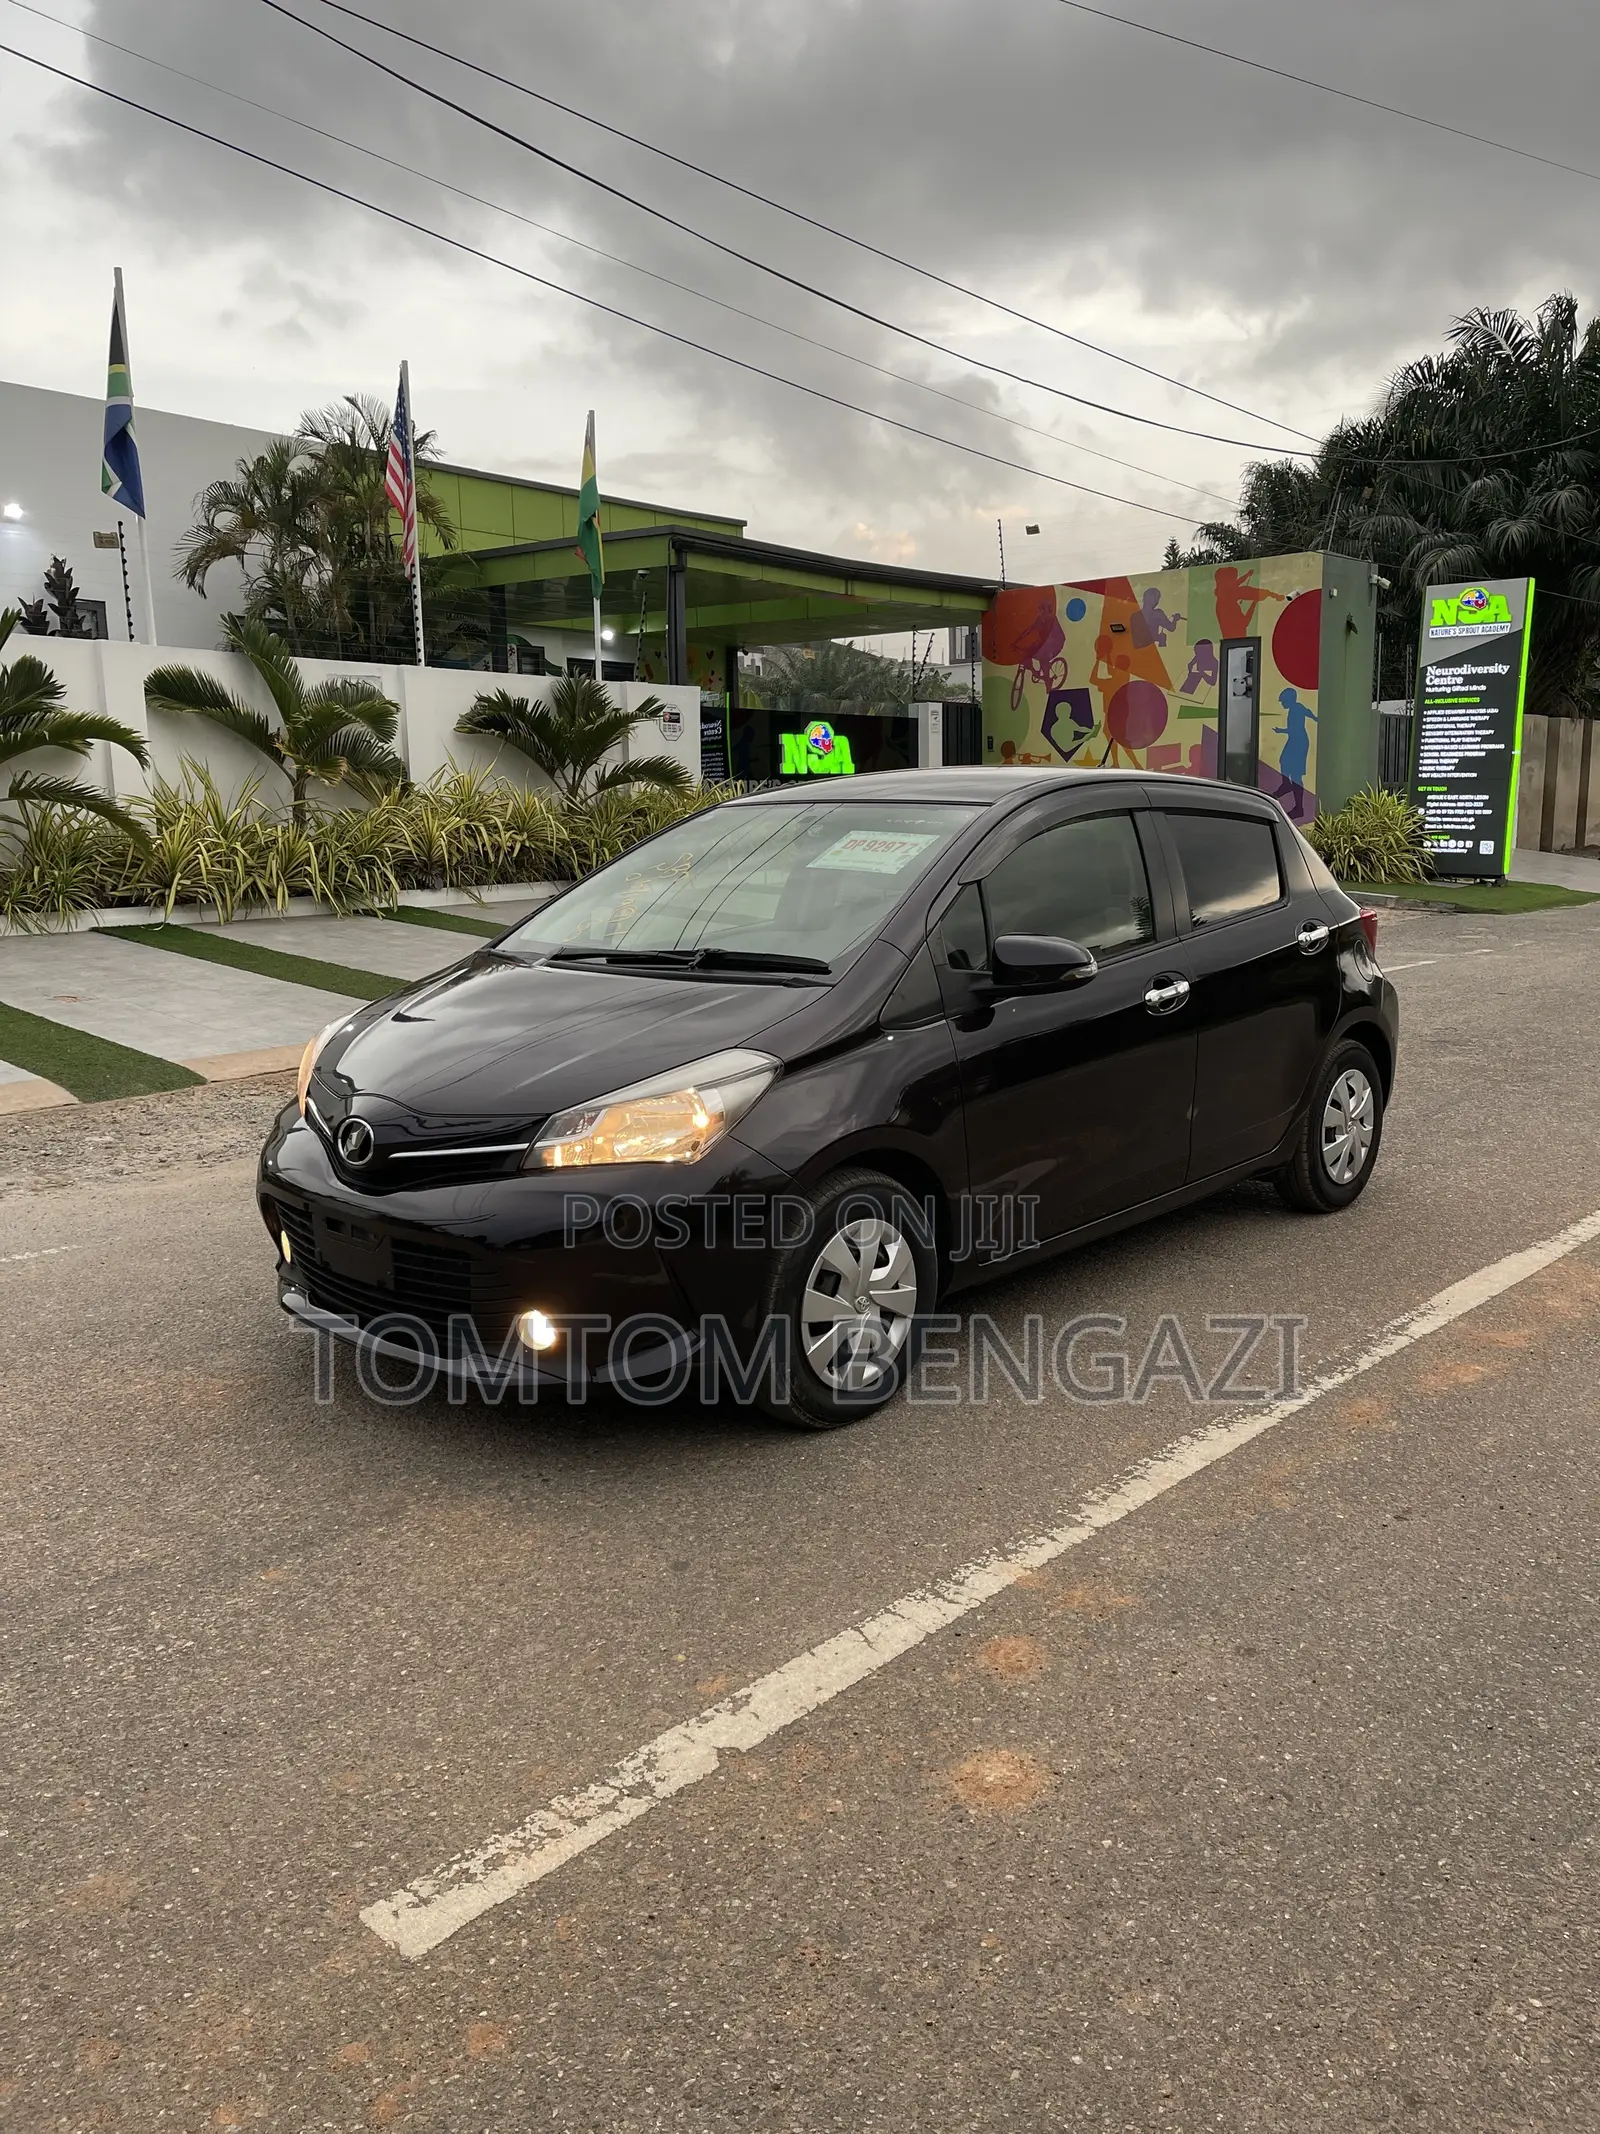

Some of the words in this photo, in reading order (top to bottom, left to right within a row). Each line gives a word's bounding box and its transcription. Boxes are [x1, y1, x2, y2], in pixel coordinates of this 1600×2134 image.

[1430, 586, 1512, 626] NSA
[1430, 628, 1456, 637] NATURE'S
[1458, 626, 1480, 634] SPROUT
[1480, 624, 1509, 633] ACADEMY
[1426, 662, 1510, 676] Neurodiversity
[1426, 675, 1464, 685] Centre
[779, 720, 855, 774] NSA
